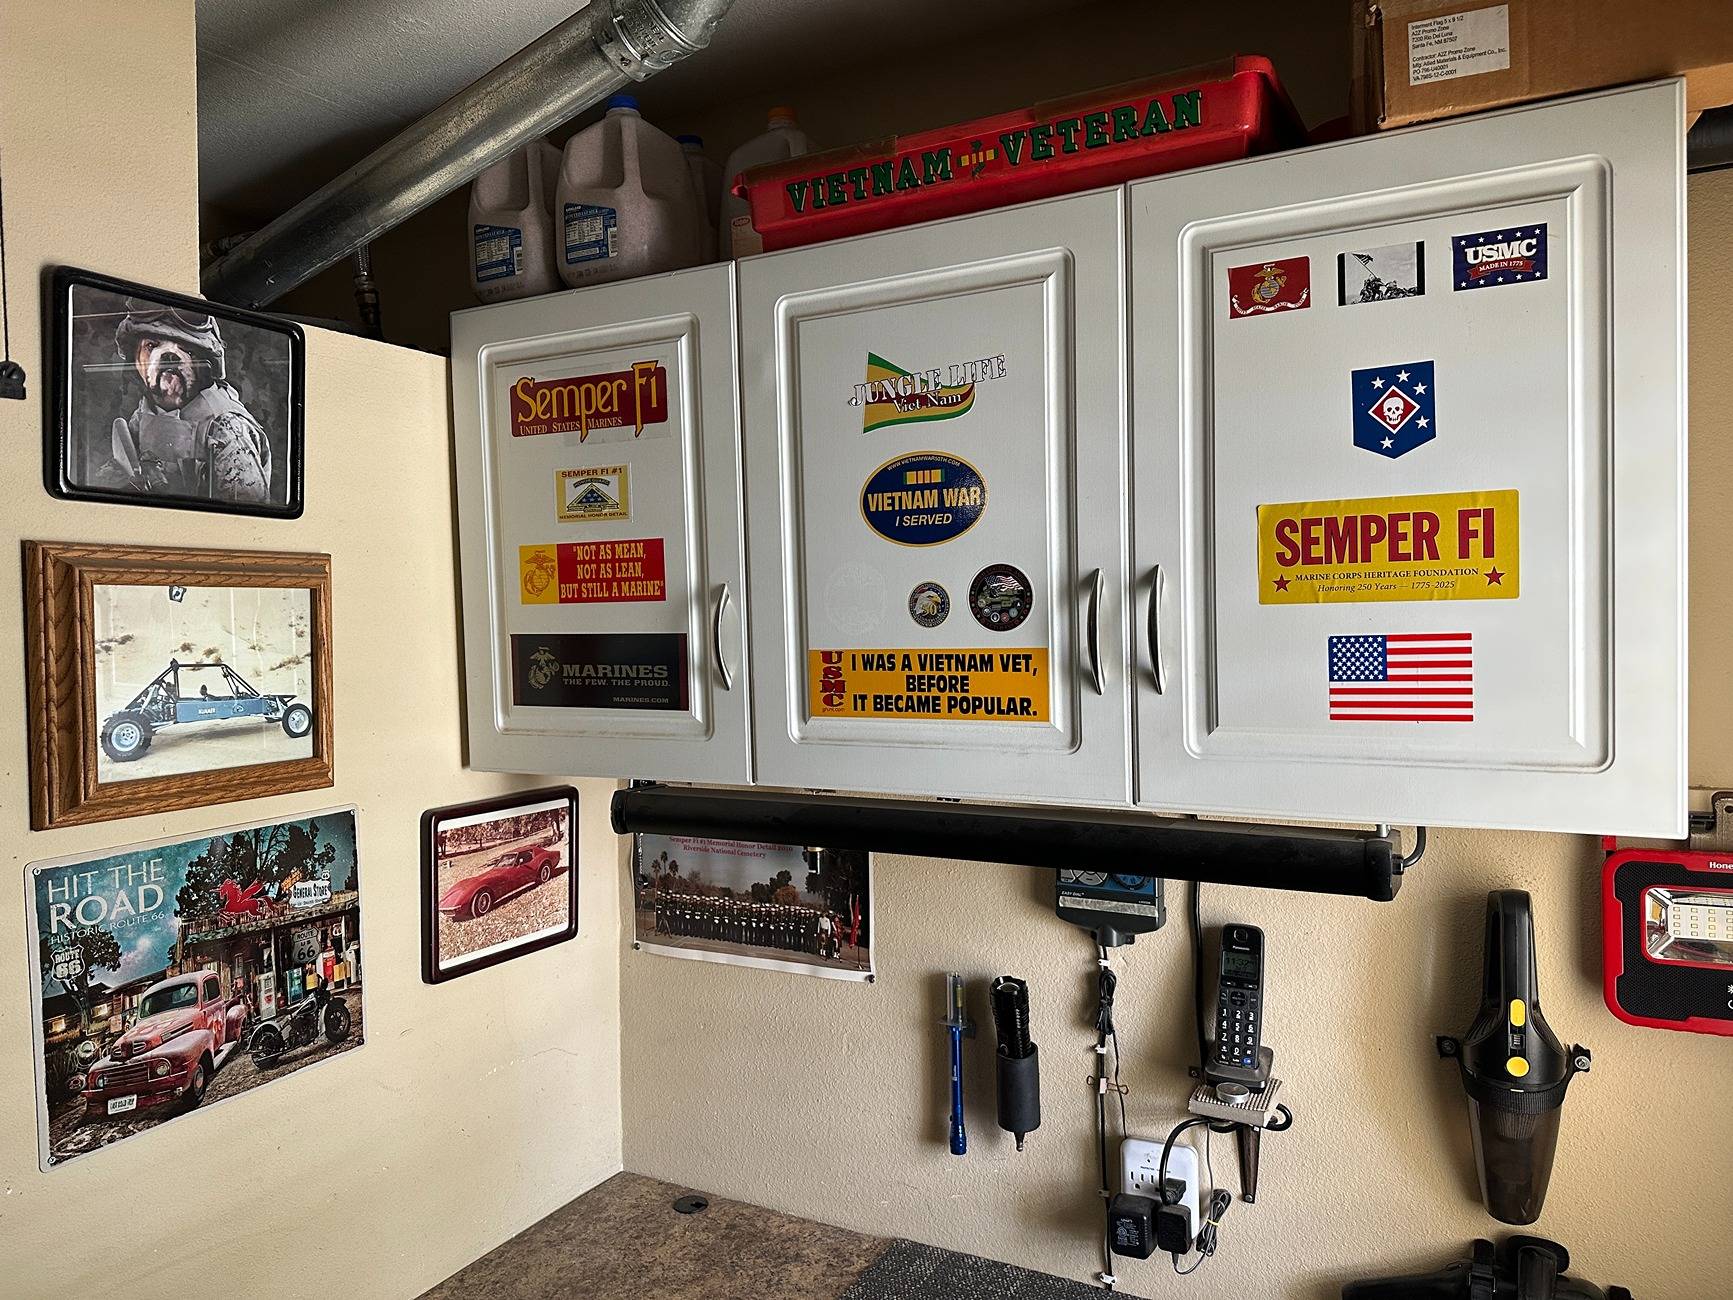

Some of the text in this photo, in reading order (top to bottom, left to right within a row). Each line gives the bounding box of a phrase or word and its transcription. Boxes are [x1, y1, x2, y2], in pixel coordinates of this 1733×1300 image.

[1437, 56, 1457, 64] Materials
[1462, 51, 1486, 59] Equipment
[787, 91, 1203, 212] VIETNAM VETERAN
[1465, 238, 1537, 264] USMC
[1479, 263, 1498, 271] MADE
[849, 354, 1007, 406] JUNGLE LIFE
[516, 360, 660, 443] Semper Fi
[894, 392, 961, 413] Viet Nam
[520, 417, 622, 436] UNITED STATES MARINES
[561, 469, 598, 477] SEMPER
[868, 486, 981, 512] VIETNAM WAR
[896, 513, 952, 526] I SERVED
[1275, 508, 1495, 567] SEMPER FI
[600, 544, 612, 560] AS
[615, 543, 646, 559] MEAN,
[577, 562, 644, 579] NOT AS LEAN,
[1414, 568, 1479, 577] FOUNDATION
[560, 584, 578, 598] BUT
[582, 583, 608, 598] STILL
[612, 583, 618, 596] A
[1318, 584, 1355, 592] Honoring
[563, 664, 668, 678] MARINES
[852, 654, 1037, 676] I WAS A VIETNAM VET,
[585, 678, 608, 686] FEW.
[634, 679, 670, 687] PROUD.
[906, 675, 969, 693] BEFORE
[853, 694, 1037, 716] IT BECAME POPULAR.
[669, 836, 691, 844] Semper
[707, 839, 736, 847] Memorial
[737, 841, 755, 849] Honor
[757, 843, 776, 851] Detail
[683, 845, 710, 853] Riverside
[48, 858, 164, 902] HIT THE
[293, 883, 328, 899] GENERAL STORE
[50, 884, 164, 934] ROAD
[51, 911, 165, 944] HISTORIC ROUTE 66
[296, 931, 314, 940] ROUTE
[55, 949, 80, 963] ROUTE
[298, 946, 316, 959] 66
[56, 960, 81, 978] 66
